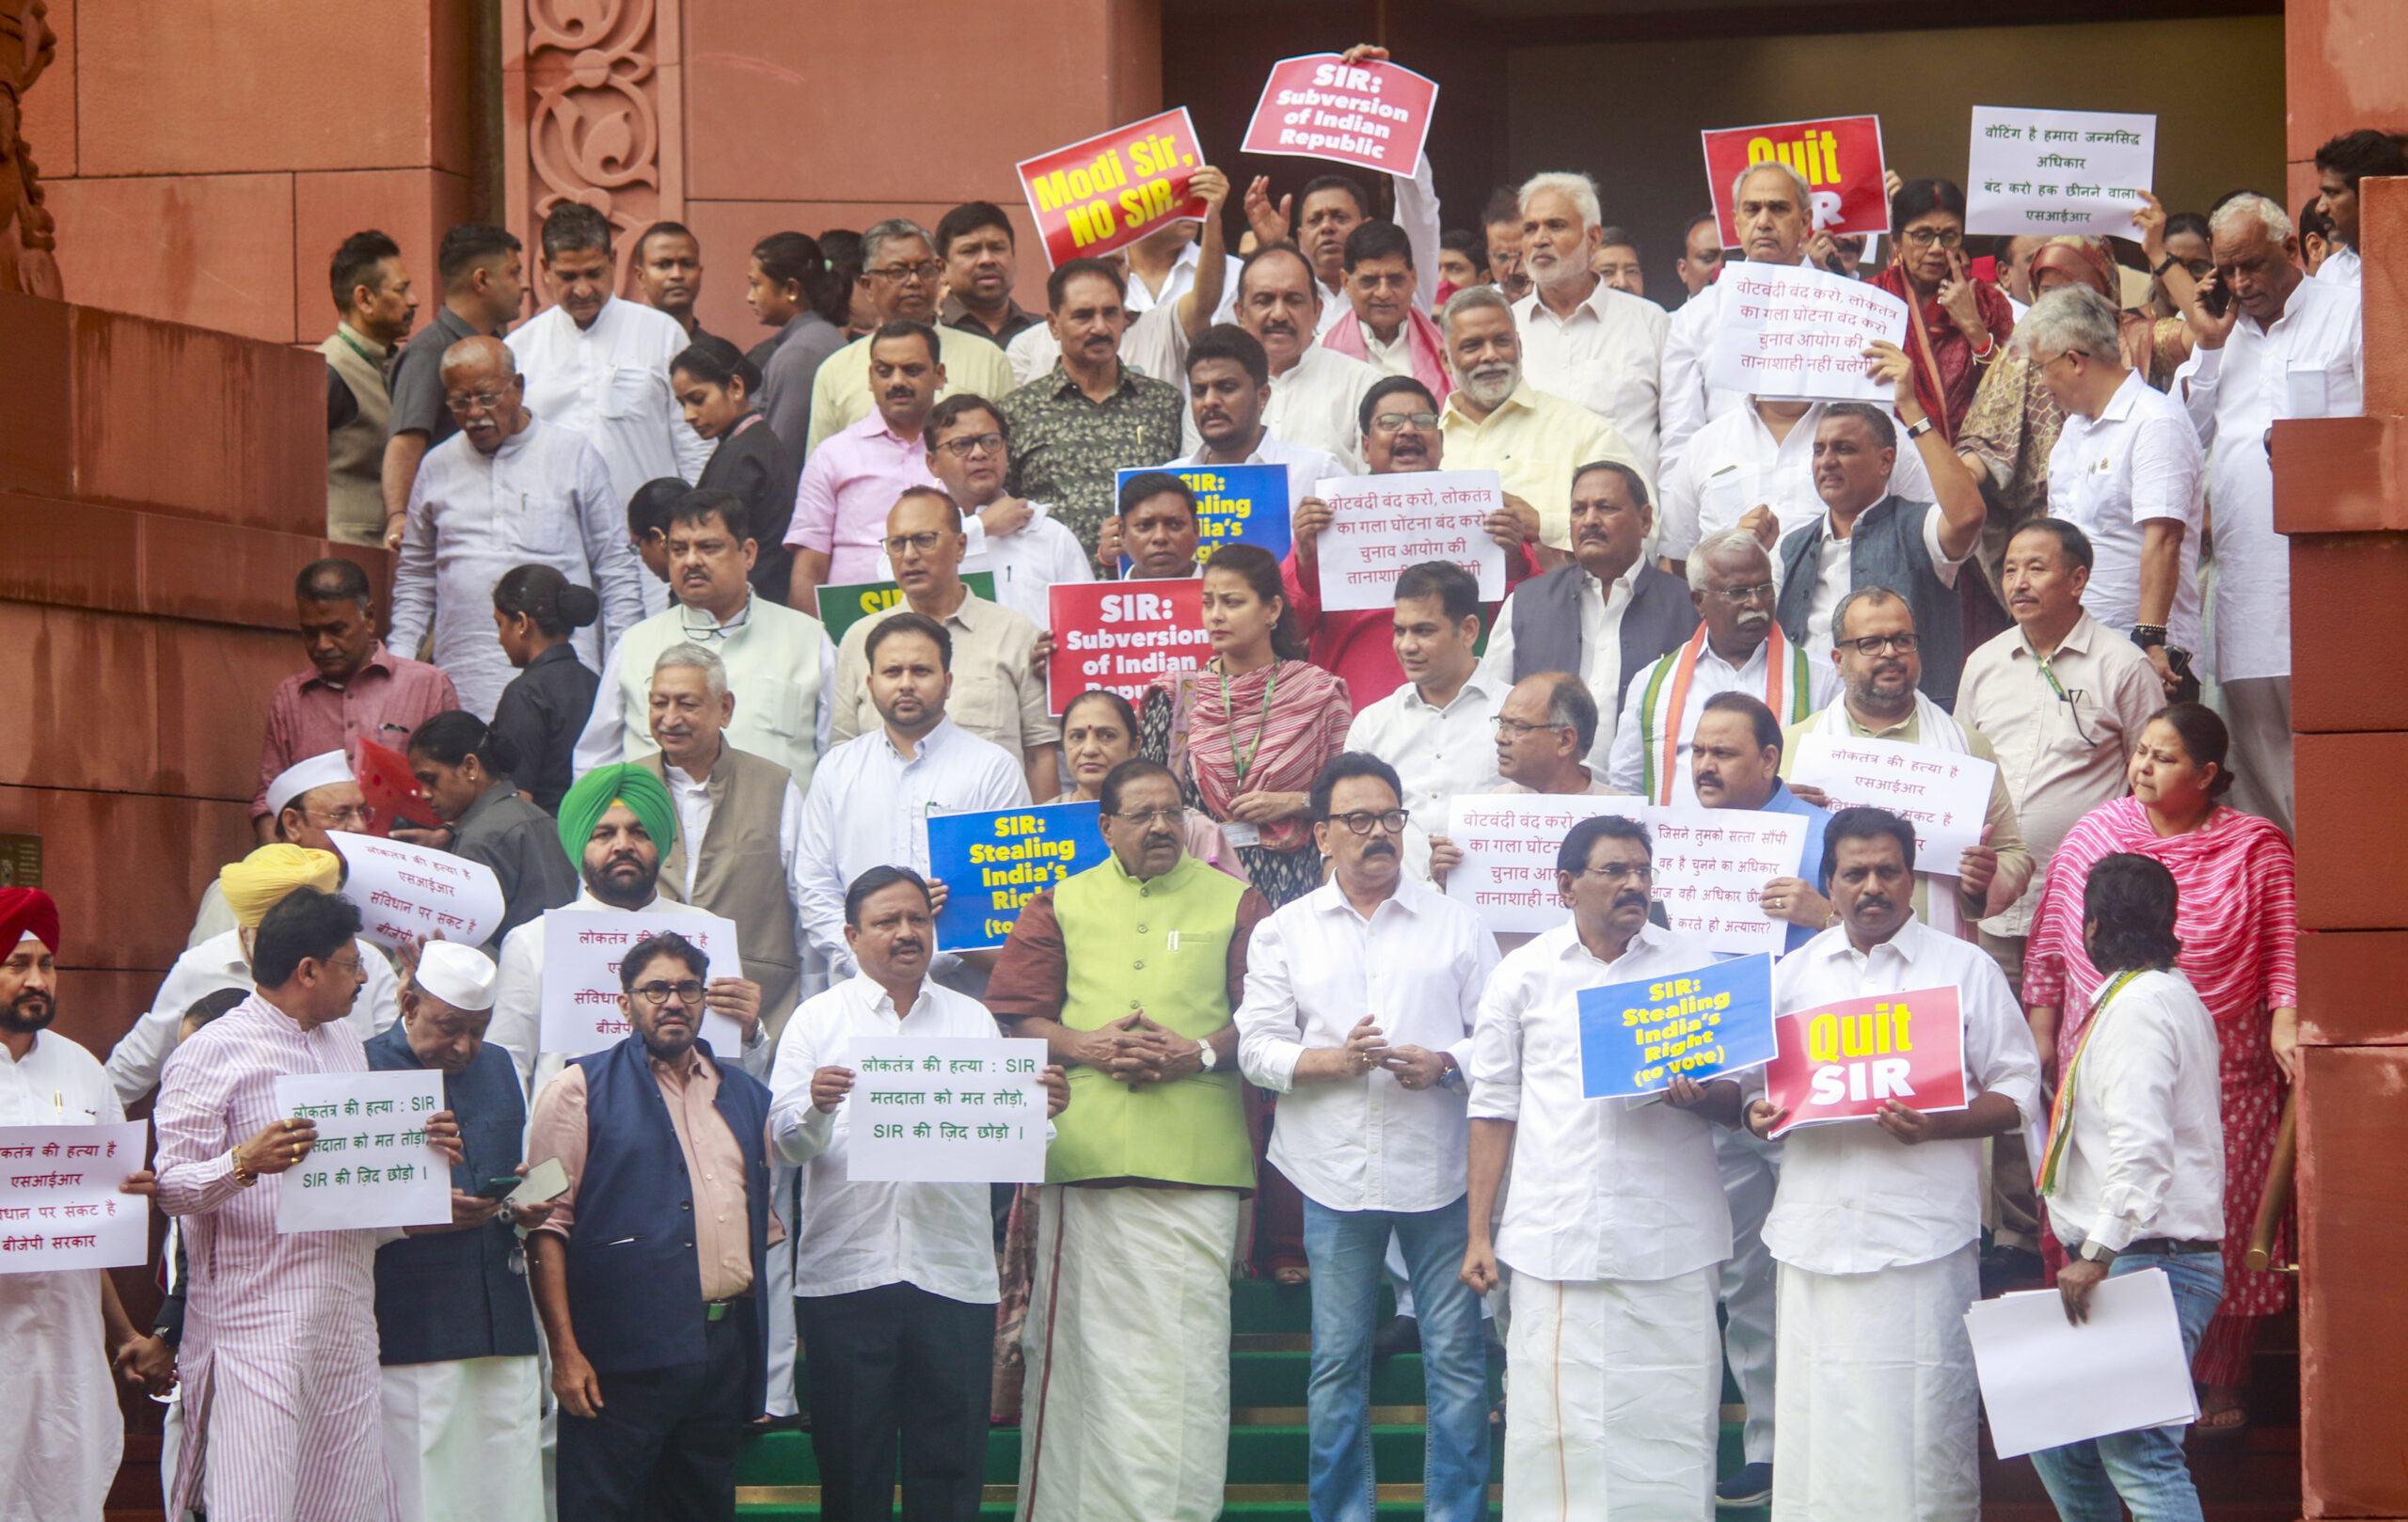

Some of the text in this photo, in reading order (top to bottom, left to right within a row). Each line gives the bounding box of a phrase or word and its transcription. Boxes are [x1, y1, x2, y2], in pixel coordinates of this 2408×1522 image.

[1312, 63, 1383, 93] SIR:
[1275, 88, 1409, 122] Subversion
[1284, 108, 1390, 139] of Indian
[1986, 124, 2021, 139] वोटिंग
[2029, 126, 2037, 141] है
[2044, 130, 2078, 142] हमारा
[1279, 129, 1386, 159] Republic
[2036, 154, 2086, 169] अधिकार
[1032, 135, 1194, 213] Modi Sir,
[2009, 182, 2031, 194] करो
[2038, 185, 2059, 197] हक
[2108, 188, 2136, 199] वाला
[1066, 178, 1183, 248] NO SIR.
[2026, 209, 2092, 223] एसआईआर
[1740, 305, 1758, 319] का
[1764, 309, 1788, 322] गला
[1861, 318, 1888, 335] करो
[1759, 331, 1863, 350] चुनाव आयोग की
[1741, 355, 1803, 371] तानाशाही
[1196, 494, 1251, 518] aling
[1441, 487, 1492, 505] लोकतंत्र
[1337, 522, 1354, 534] का
[1360, 520, 1386, 533] गला
[1391, 515, 1431, 532] घोंटना
[1360, 538, 1466, 563] चुनाव आयोग की
[1101, 594, 1173, 623] SIR:
[1067, 625, 1210, 651] Subversion
[1083, 651, 1196, 675] of Indian
[1831, 749, 1959, 779] लोकतंत्र की हत्या है
[1855, 776, 1926, 796] एसआईआर
[994, 816, 1046, 837] SIR:
[1943, 812, 1954, 827] है
[1469, 838, 1490, 852] का
[1494, 839, 1522, 853] गला
[1658, 824, 1689, 839] जिसने
[1695, 827, 1723, 847] तुमको
[970, 837, 1075, 864] Stealing
[982, 862, 1068, 887] India's
[1491, 866, 1529, 884] चुनाव
[1659, 858, 1673, 870] वह
[1679, 854, 1687, 871] है
[1721, 861, 1733, 872] का
[1737, 858, 1780, 875] अधिकार
[1475, 888, 1542, 907] तानाशाही
[1679, 885, 1697, 900] वही
[1703, 886, 1741, 902] अधिकार
[371, 889, 414, 914] संविधान
[419, 906, 433, 921] पर
[437, 910, 464, 930] संकट
[1678, 917, 1703, 930] करते
[1709, 915, 1719, 932] हो
[579, 928, 628, 944] लोकतंत्र
[700, 932, 709, 949] है
[1649, 978, 1702, 1002] SIR:
[1623, 991, 1731, 1026] Stealing
[1636, 1013, 1721, 1045] India's
[1809, 1003, 1912, 1063] Quit
[1645, 1030, 1714, 1063] Right
[861, 1055, 914, 1072] लोकतंत्र
[923, 1055, 942, 1072] की
[949, 1060, 983, 1074] हत्या
[1006, 1058, 1036, 1073] SIR
[1635, 1045, 1725, 1087] (to vote)
[1809, 1058, 1916, 1105] SIR
[292, 1101, 338, 1118] लोकतंत्र
[344, 1099, 359, 1116] की
[366, 1101, 394, 1117] हत्या
[411, 1096, 436, 1112] SIR
[871, 1092, 926, 1105] मतदाता
[934, 1088, 952, 1105] को
[960, 1092, 986, 1105] मत
[874, 1124, 903, 1139] SIR
[913, 1122, 931, 1138] की
[0, 1141, 117, 1158] कतंत्र की हत्या है
[311, 1137, 347, 1153] तदाता
[354, 1133, 369, 1149] को
[374, 1134, 395, 1148] मत
[11, 1171, 84, 1188] एसआईआर
[303, 1173, 327, 1188] SIR
[335, 1168, 351, 1184] की
[39, 1207, 56, 1218] पर
[64, 1201, 99, 1217] संकट
[105, 1199, 116, 1216] है
[2, 1234, 96, 1251] बीजेपी सरकार
